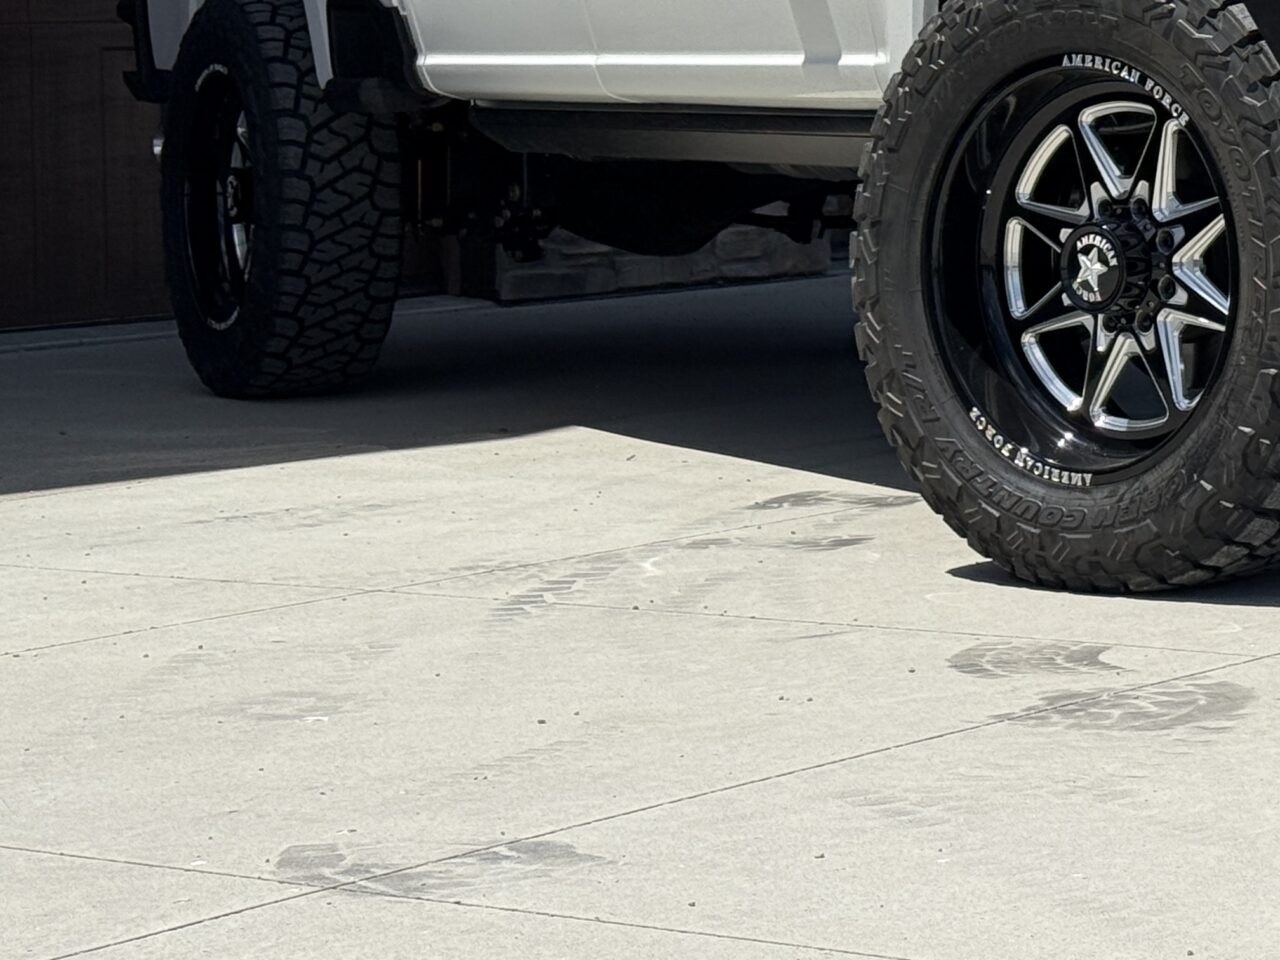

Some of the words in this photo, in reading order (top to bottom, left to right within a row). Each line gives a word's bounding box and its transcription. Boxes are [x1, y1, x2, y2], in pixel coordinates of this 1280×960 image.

[1062, 54, 1142, 84] AMERICAN
[1145, 78, 1190, 126] FORCE
[1179, 62, 1251, 182] TOYO
[1076, 233, 1119, 266] AMERICAN
[968, 406, 1014, 457] FORCE
[935, 437, 1087, 530] COUNTRY
[1014, 449, 1093, 487] AMERICAN
